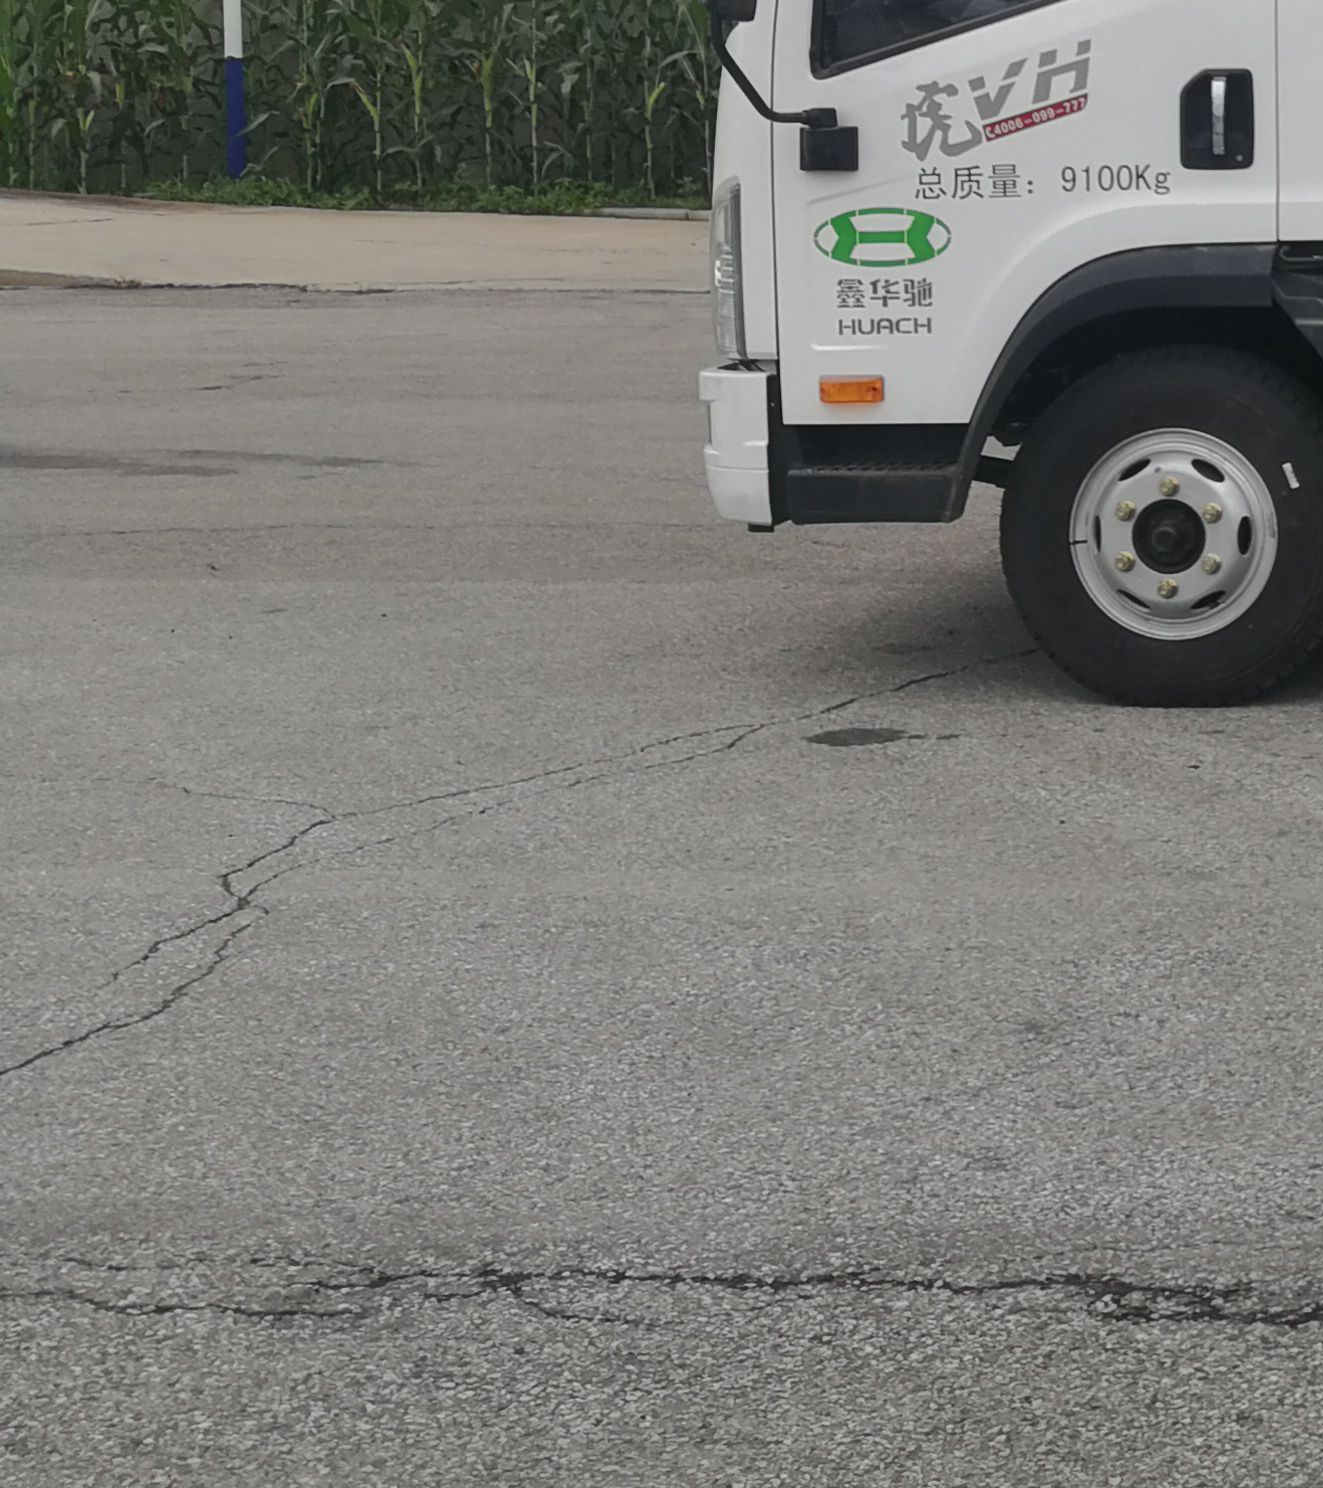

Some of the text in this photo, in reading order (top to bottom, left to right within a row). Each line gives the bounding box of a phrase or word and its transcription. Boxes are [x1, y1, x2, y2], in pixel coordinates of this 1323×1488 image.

[836, 277, 934, 309] 鑫华驰
[838, 316, 933, 336] HUACH
